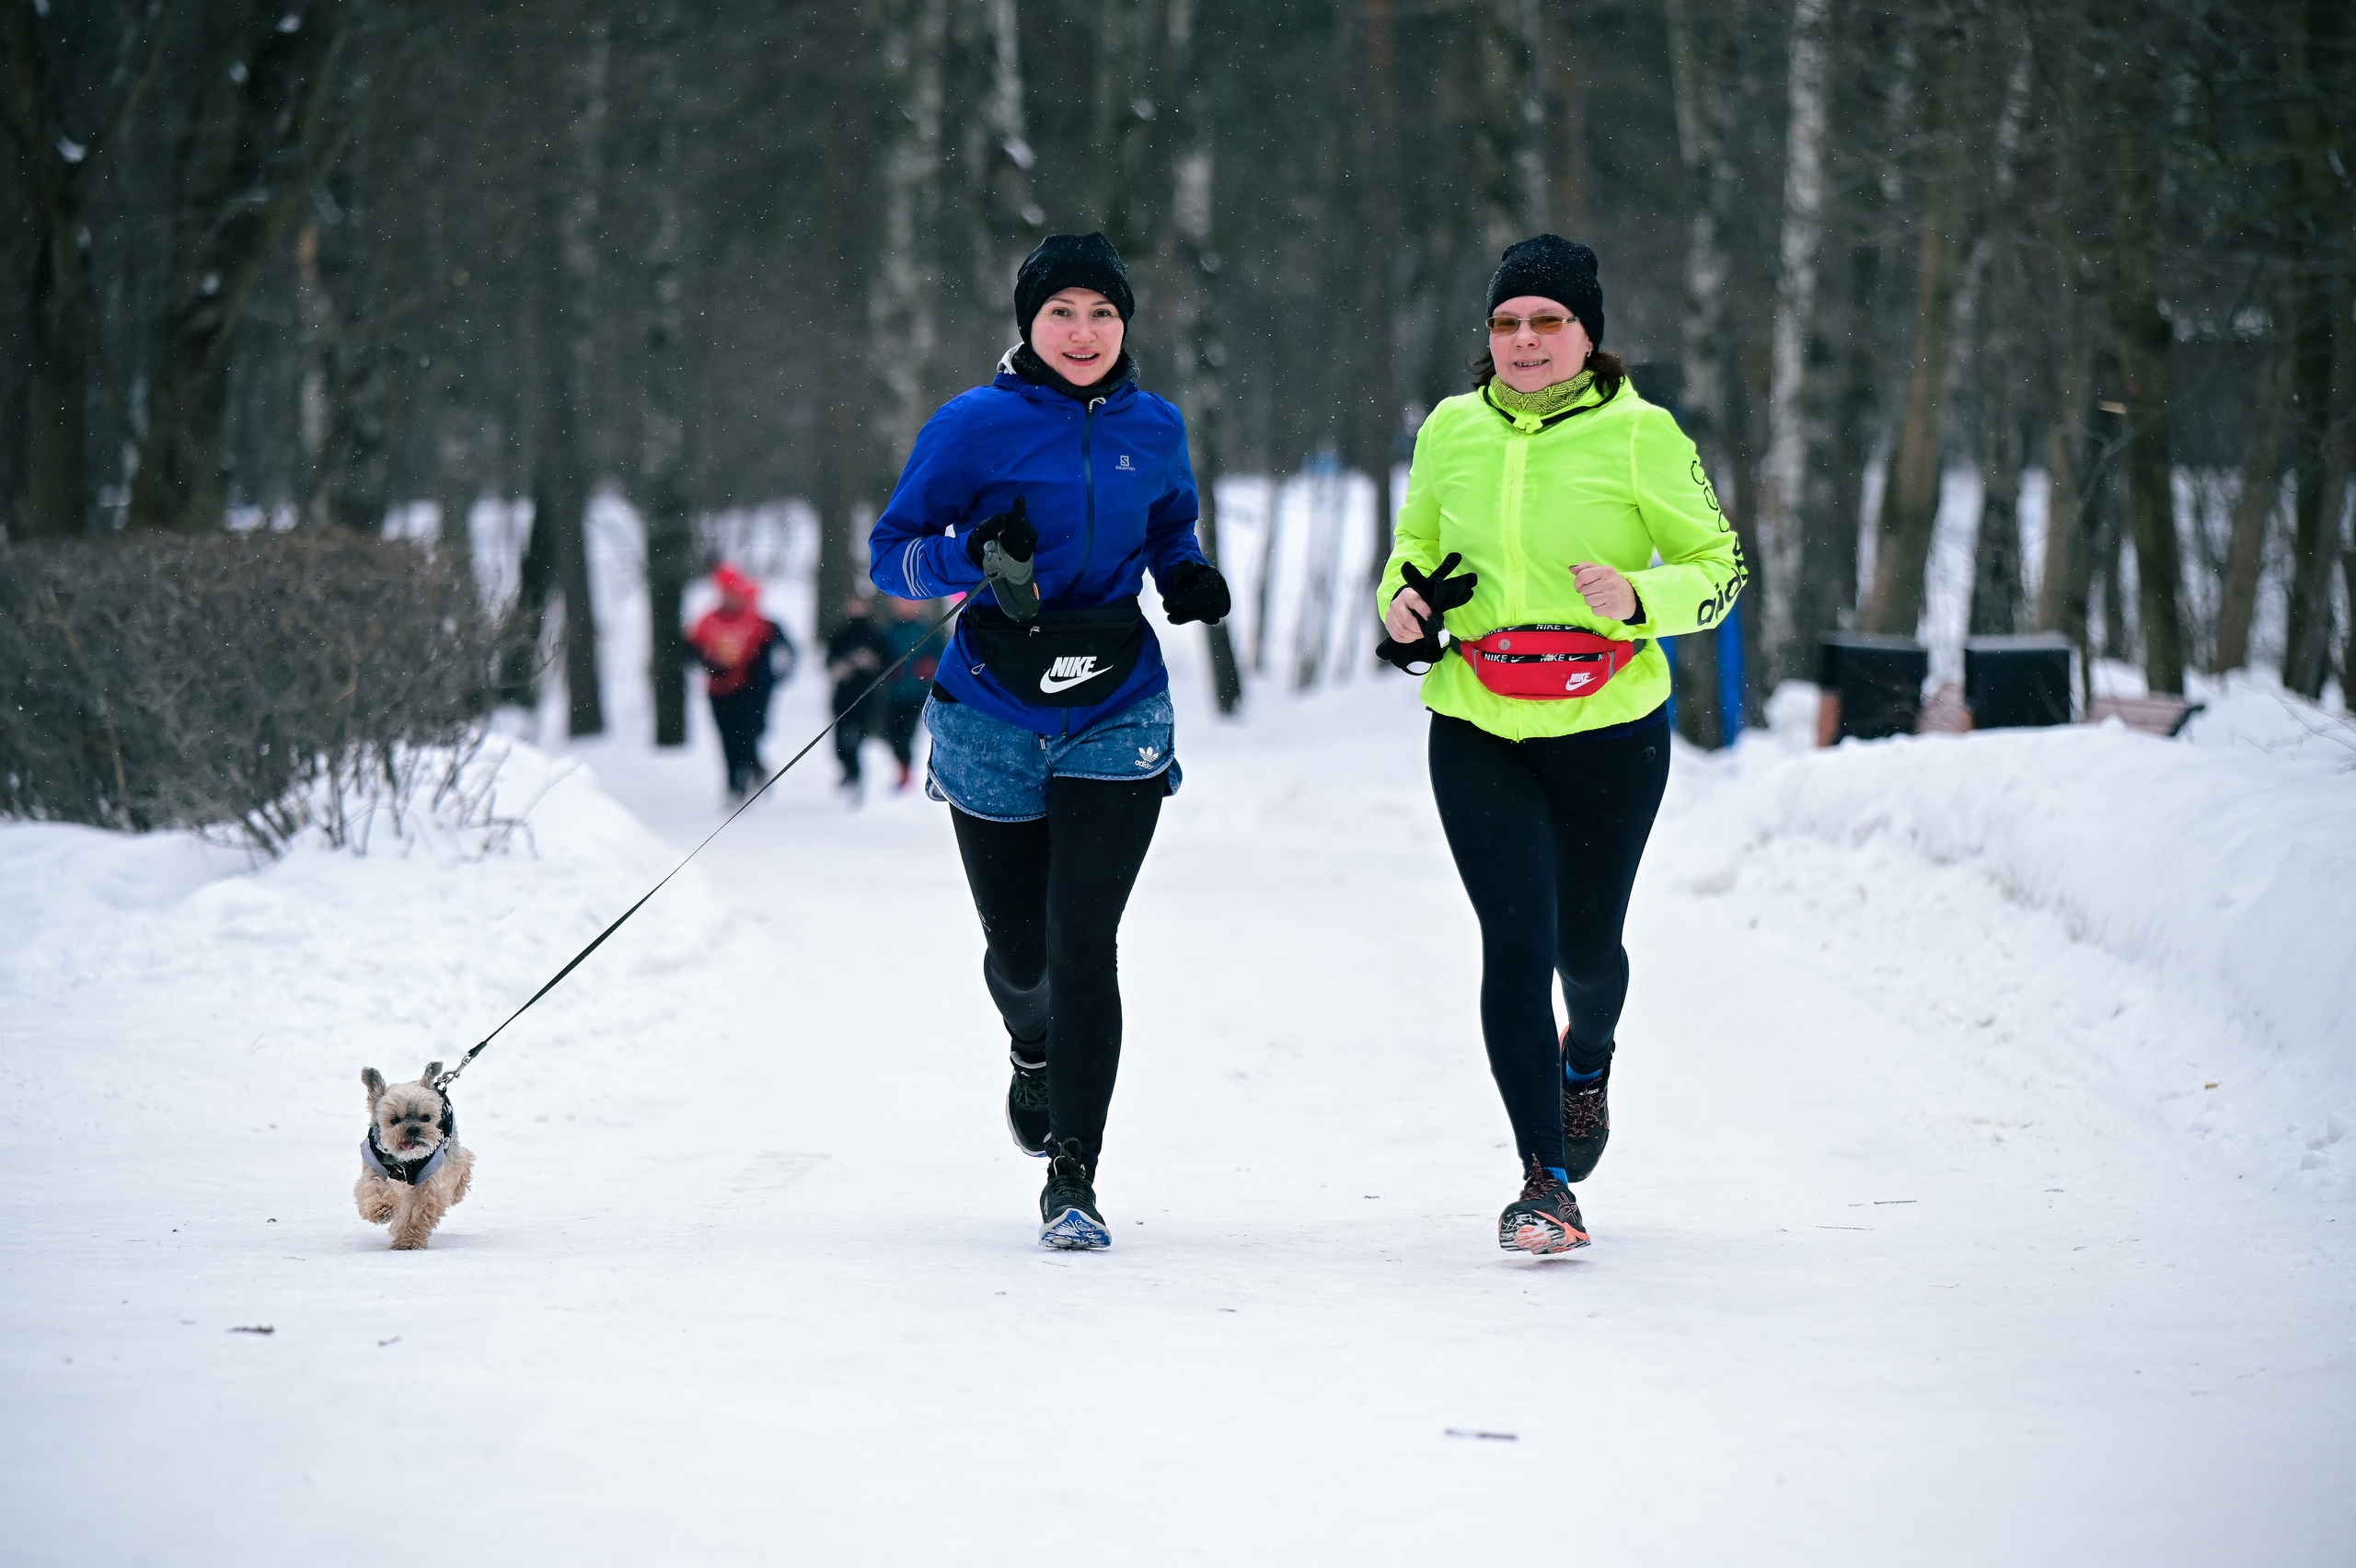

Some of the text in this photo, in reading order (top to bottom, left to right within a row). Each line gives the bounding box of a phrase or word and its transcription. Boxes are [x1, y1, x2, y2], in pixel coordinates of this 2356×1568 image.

[1484, 652, 1508, 663] NIKE
[1540, 653, 1565, 663] NKE
[1050, 656, 1097, 677] NIKE
[1570, 673, 1590, 683] NIKE
